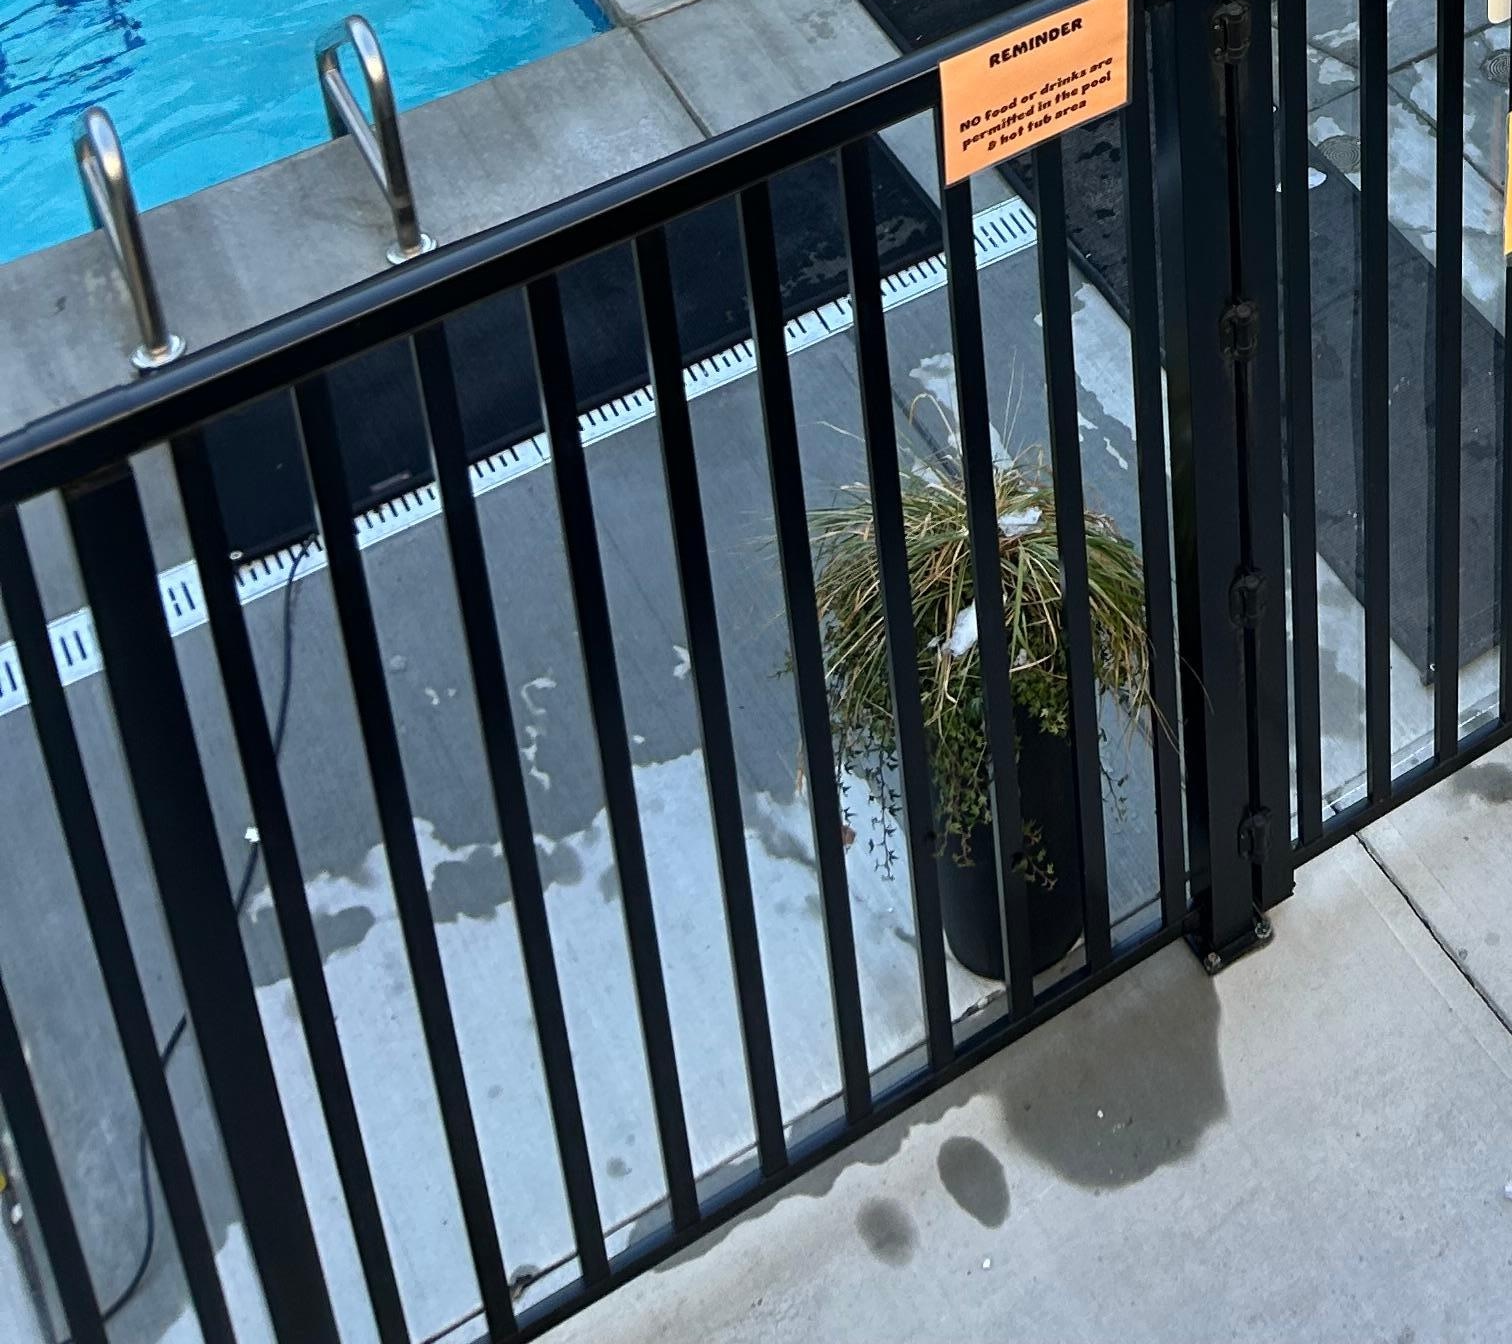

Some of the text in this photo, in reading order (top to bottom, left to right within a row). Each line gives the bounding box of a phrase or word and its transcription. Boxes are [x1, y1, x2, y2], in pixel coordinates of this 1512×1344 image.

[989, 17, 1083, 69] REMINDER
[959, 56, 1113, 133] NO food or drinks are
[962, 70, 1112, 152] permitted in the pool
[1000, 124, 1024, 147] hot
[1027, 114, 1052, 133] tub
[1055, 98, 1087, 119] area
